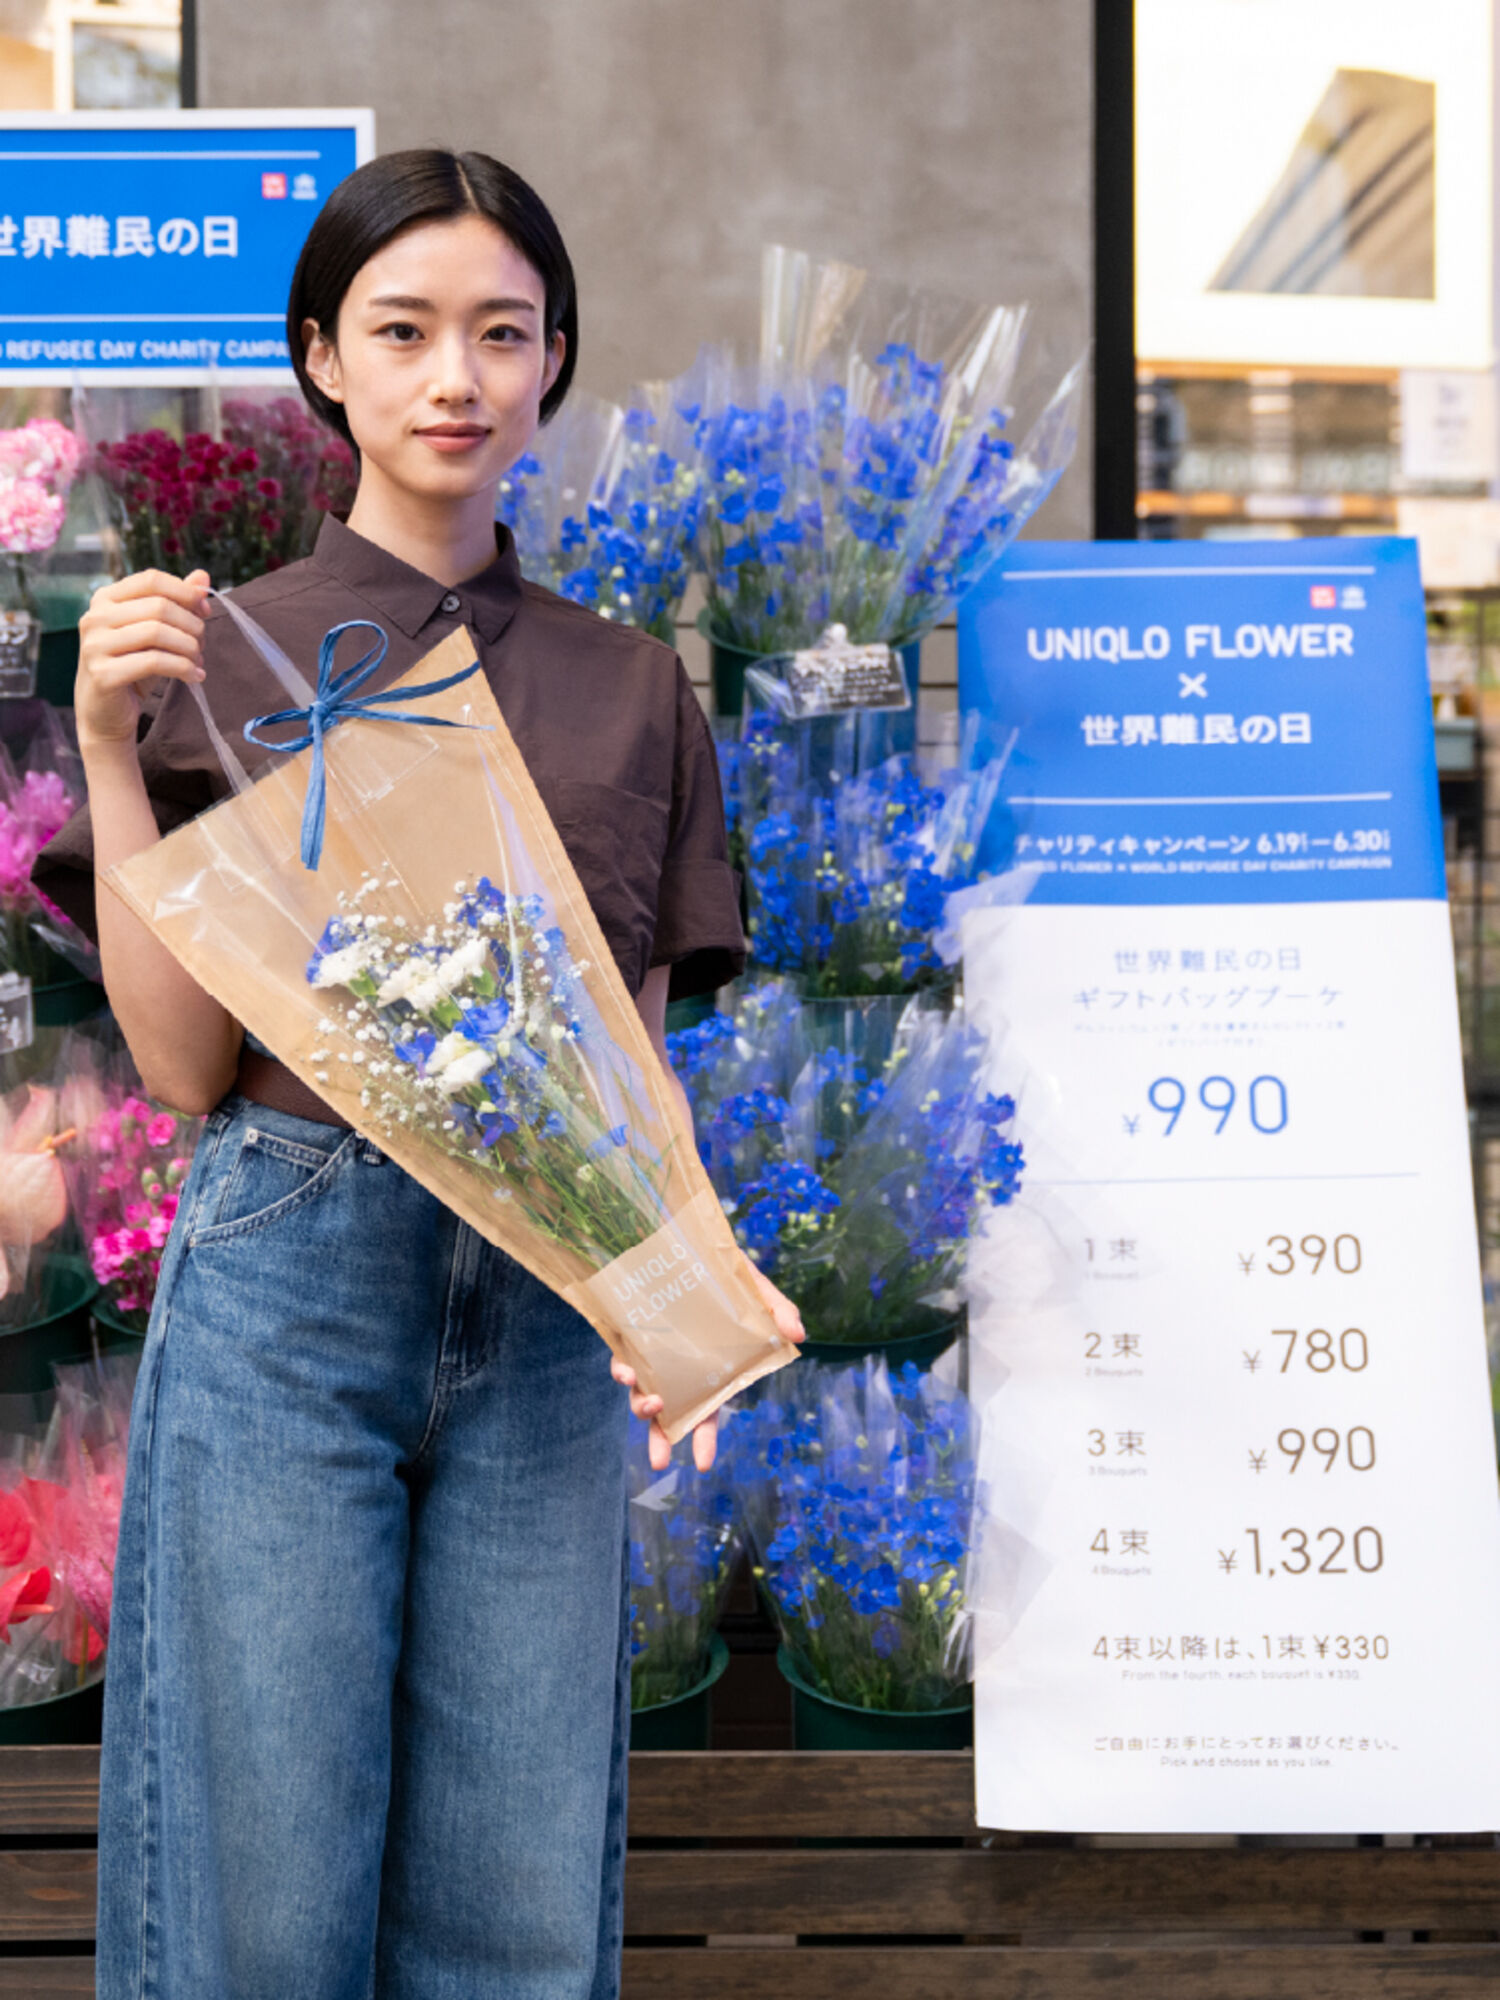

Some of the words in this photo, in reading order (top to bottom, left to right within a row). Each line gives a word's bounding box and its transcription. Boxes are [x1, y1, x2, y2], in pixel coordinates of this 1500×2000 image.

[6, 340, 95, 360] REFUGEE
[100, 340, 136, 359] DAY
[141, 339, 220, 359] CHARITY
[225, 340, 289, 359] CAMPA
[1027, 625, 1170, 663] UNIQLO
[1186, 623, 1353, 658] FLOWER
[1082, 713, 1311, 745] 世界難民の日
[1114, 948, 1300, 973] 世界難民の日
[1122, 1075, 1288, 1136] ¥990
[612, 1243, 687, 1302] UNIQLO
[1238, 1233, 1362, 1276] ¥390
[626, 1261, 707, 1327] FLOWER
[1243, 1328, 1369, 1373] ¥780
[1248, 1426, 1377, 1474] ¥990
[1219, 1526, 1383, 1577] ¥1,320
